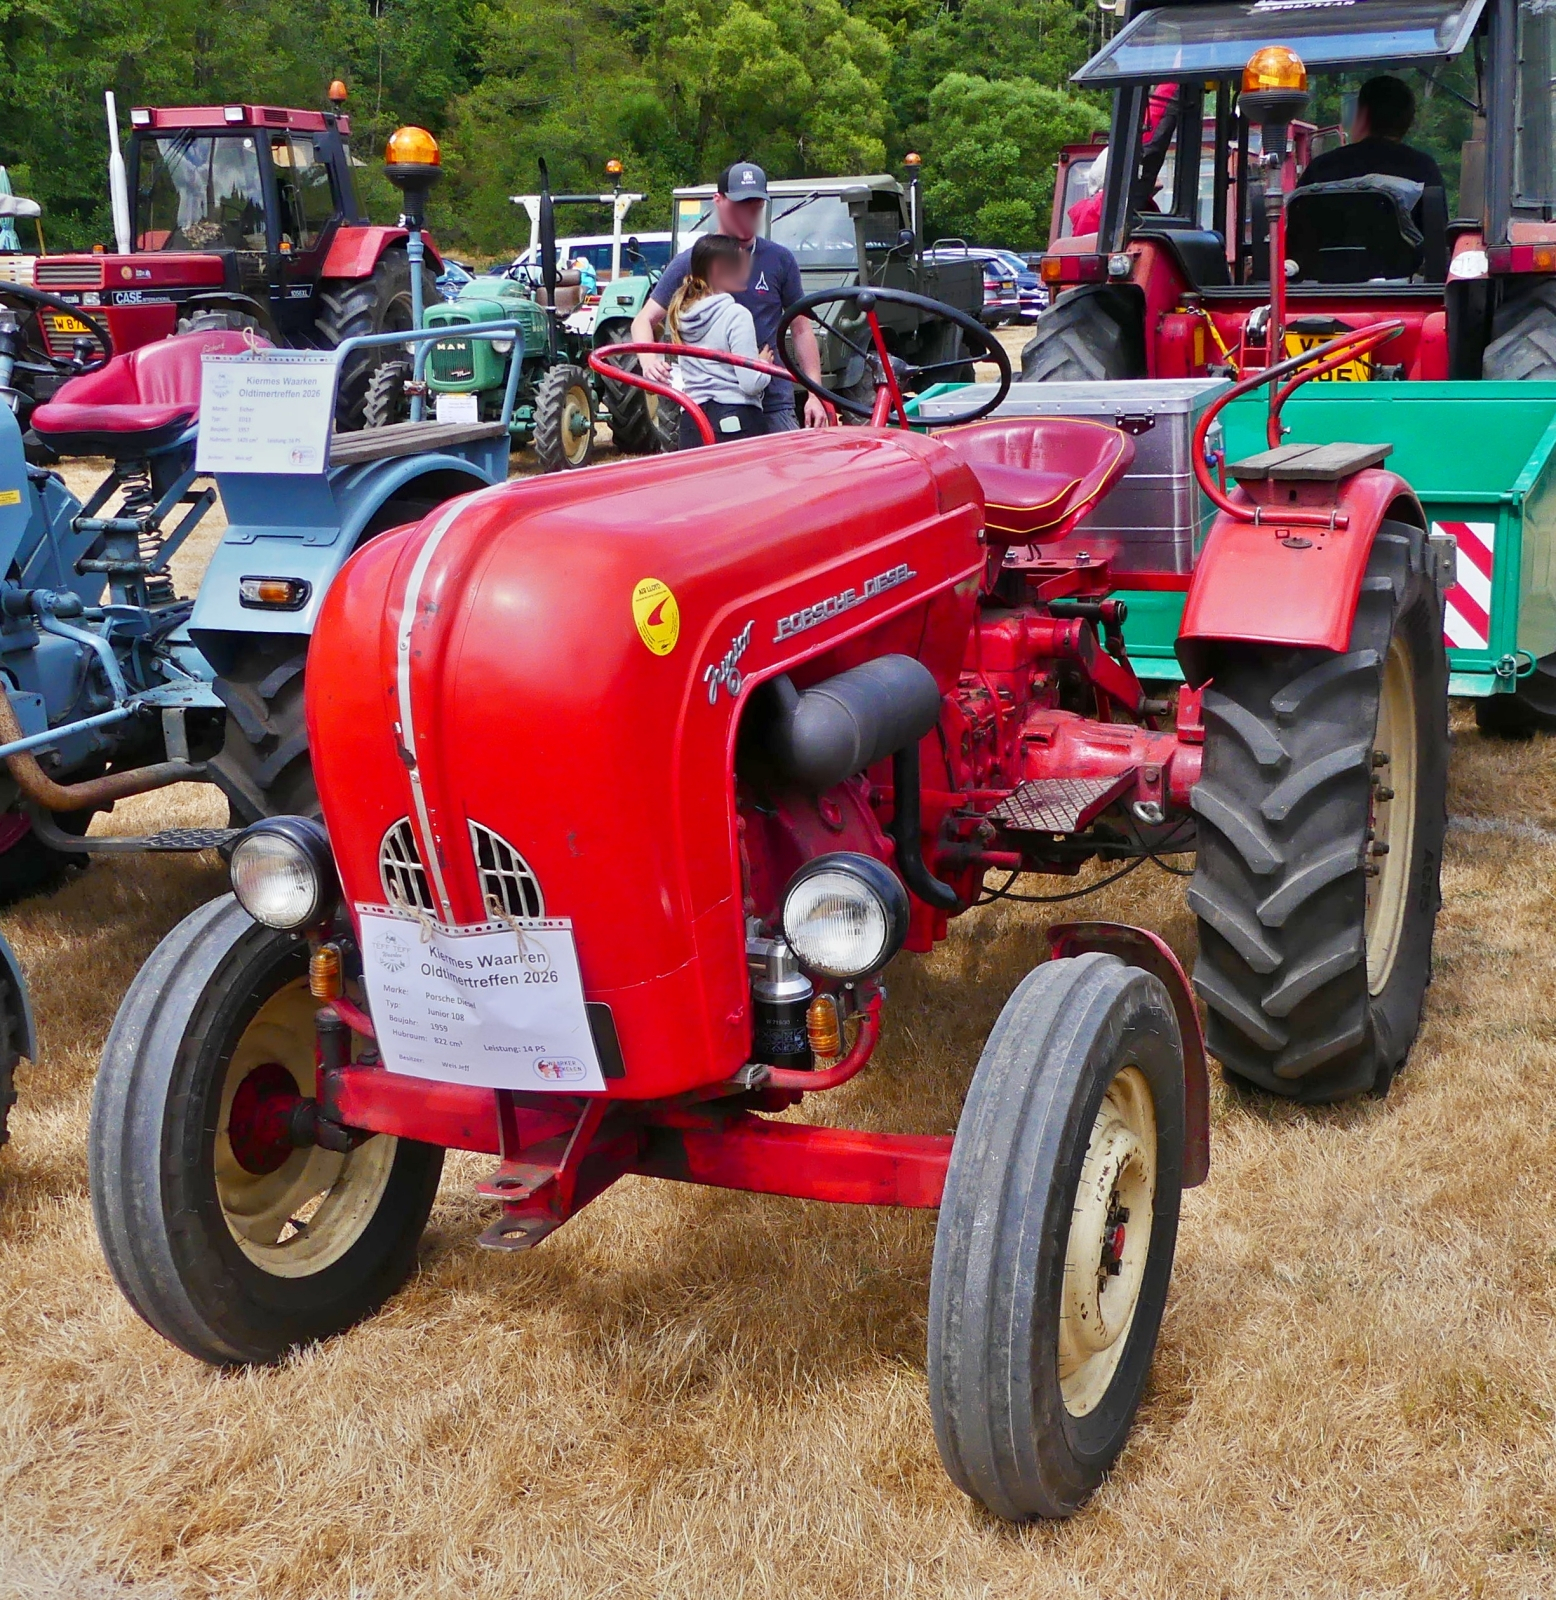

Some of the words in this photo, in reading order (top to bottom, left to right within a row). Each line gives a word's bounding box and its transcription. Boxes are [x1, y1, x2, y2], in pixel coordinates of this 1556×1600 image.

[116, 291, 142, 304] CASE
[56, 319, 64, 330] W
[246, 376, 280, 385] Kiermes
[239, 389, 300, 398] Oldtimertreffen
[302, 390, 320, 398] 2026
[773, 588, 857, 643] PORSCHE
[861, 564, 917, 600] DIESEL
[704, 620, 755, 705] Junior
[428, 945, 473, 970] Kiermes
[421, 963, 519, 988] Oldtimertreffen
[523, 970, 558, 984] 2026
[384, 984, 408, 995] Marke:
[426, 992, 455, 1004] Porsche
[457, 997, 476, 1009] Diesel
[386, 1000, 400, 1008] Typ:
[428, 1008, 449, 1018] Junior
[452, 1012, 464, 1022] 108
[389, 1014, 418, 1026] Baujahr:
[430, 1023, 448, 1032] 1959
[392, 1029, 427, 1042] Hubraum:
[434, 1037, 448, 1046] 822
[484, 1044, 521, 1054] Leistung:
